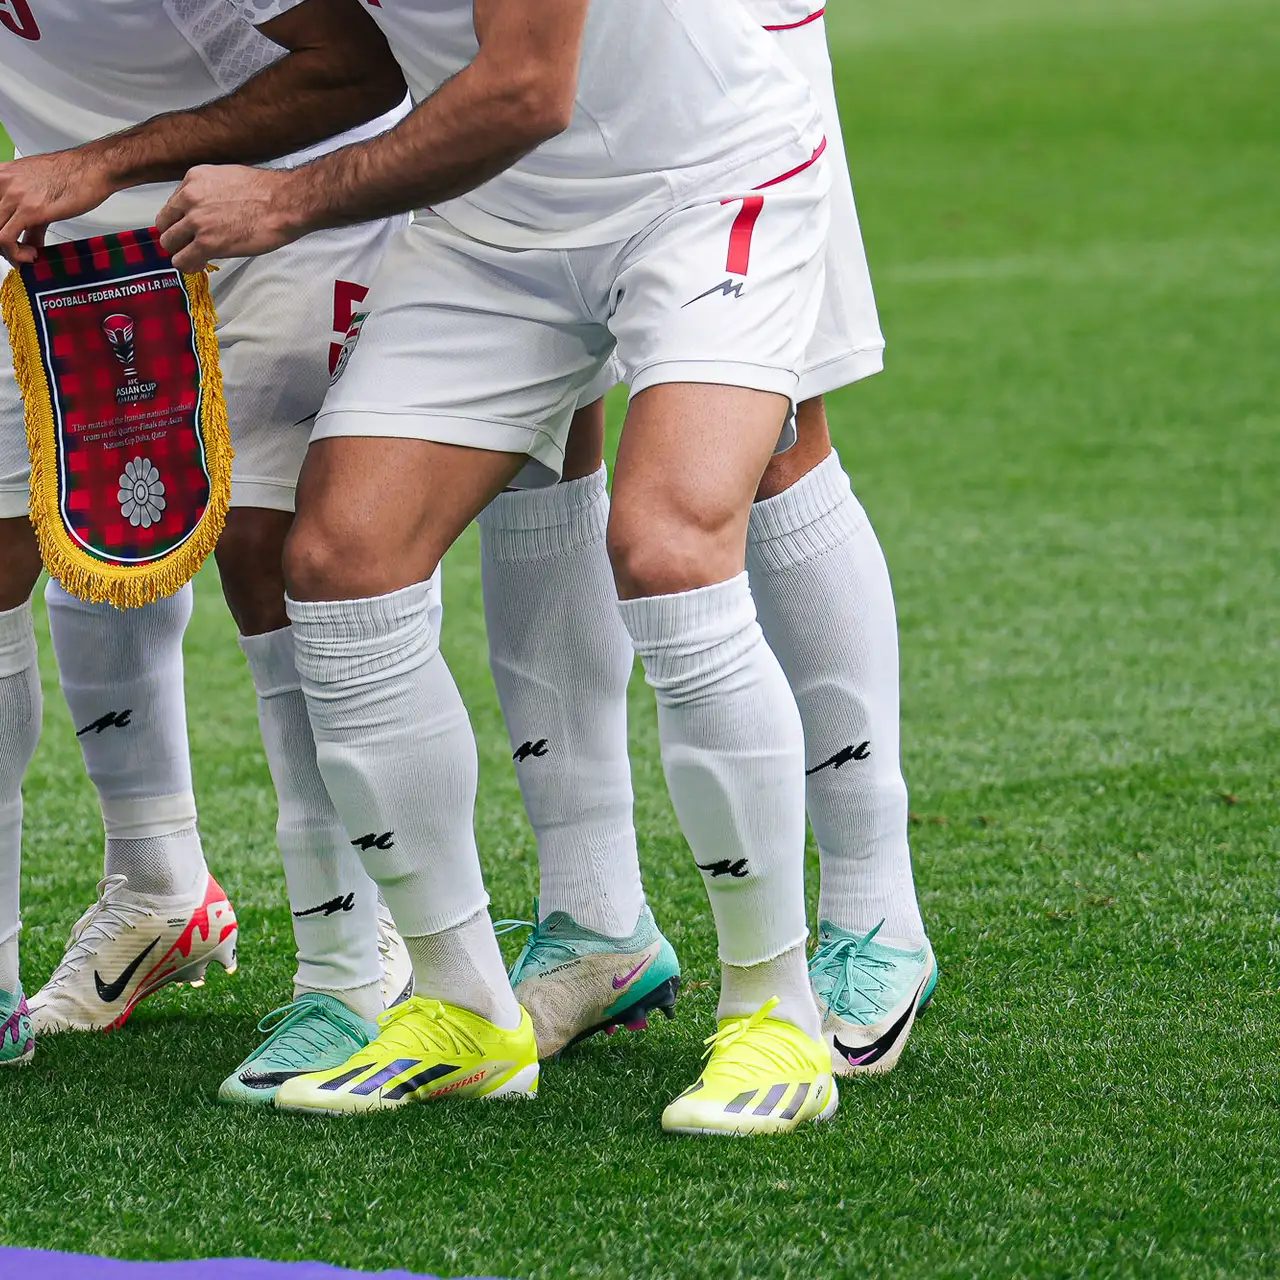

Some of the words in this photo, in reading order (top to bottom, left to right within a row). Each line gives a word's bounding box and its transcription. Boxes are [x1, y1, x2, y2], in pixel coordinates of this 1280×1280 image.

[720, 194, 765, 277] 7
[41, 294, 87, 311] FOOTBALL
[87, 283, 147, 303] FEDERATION
[161, 277, 179, 289] IRAN
[116, 384, 140, 397] ASIAN
[139, 382, 157, 393] CUP
[428, 1069, 487, 1099] CRAZYFAST
